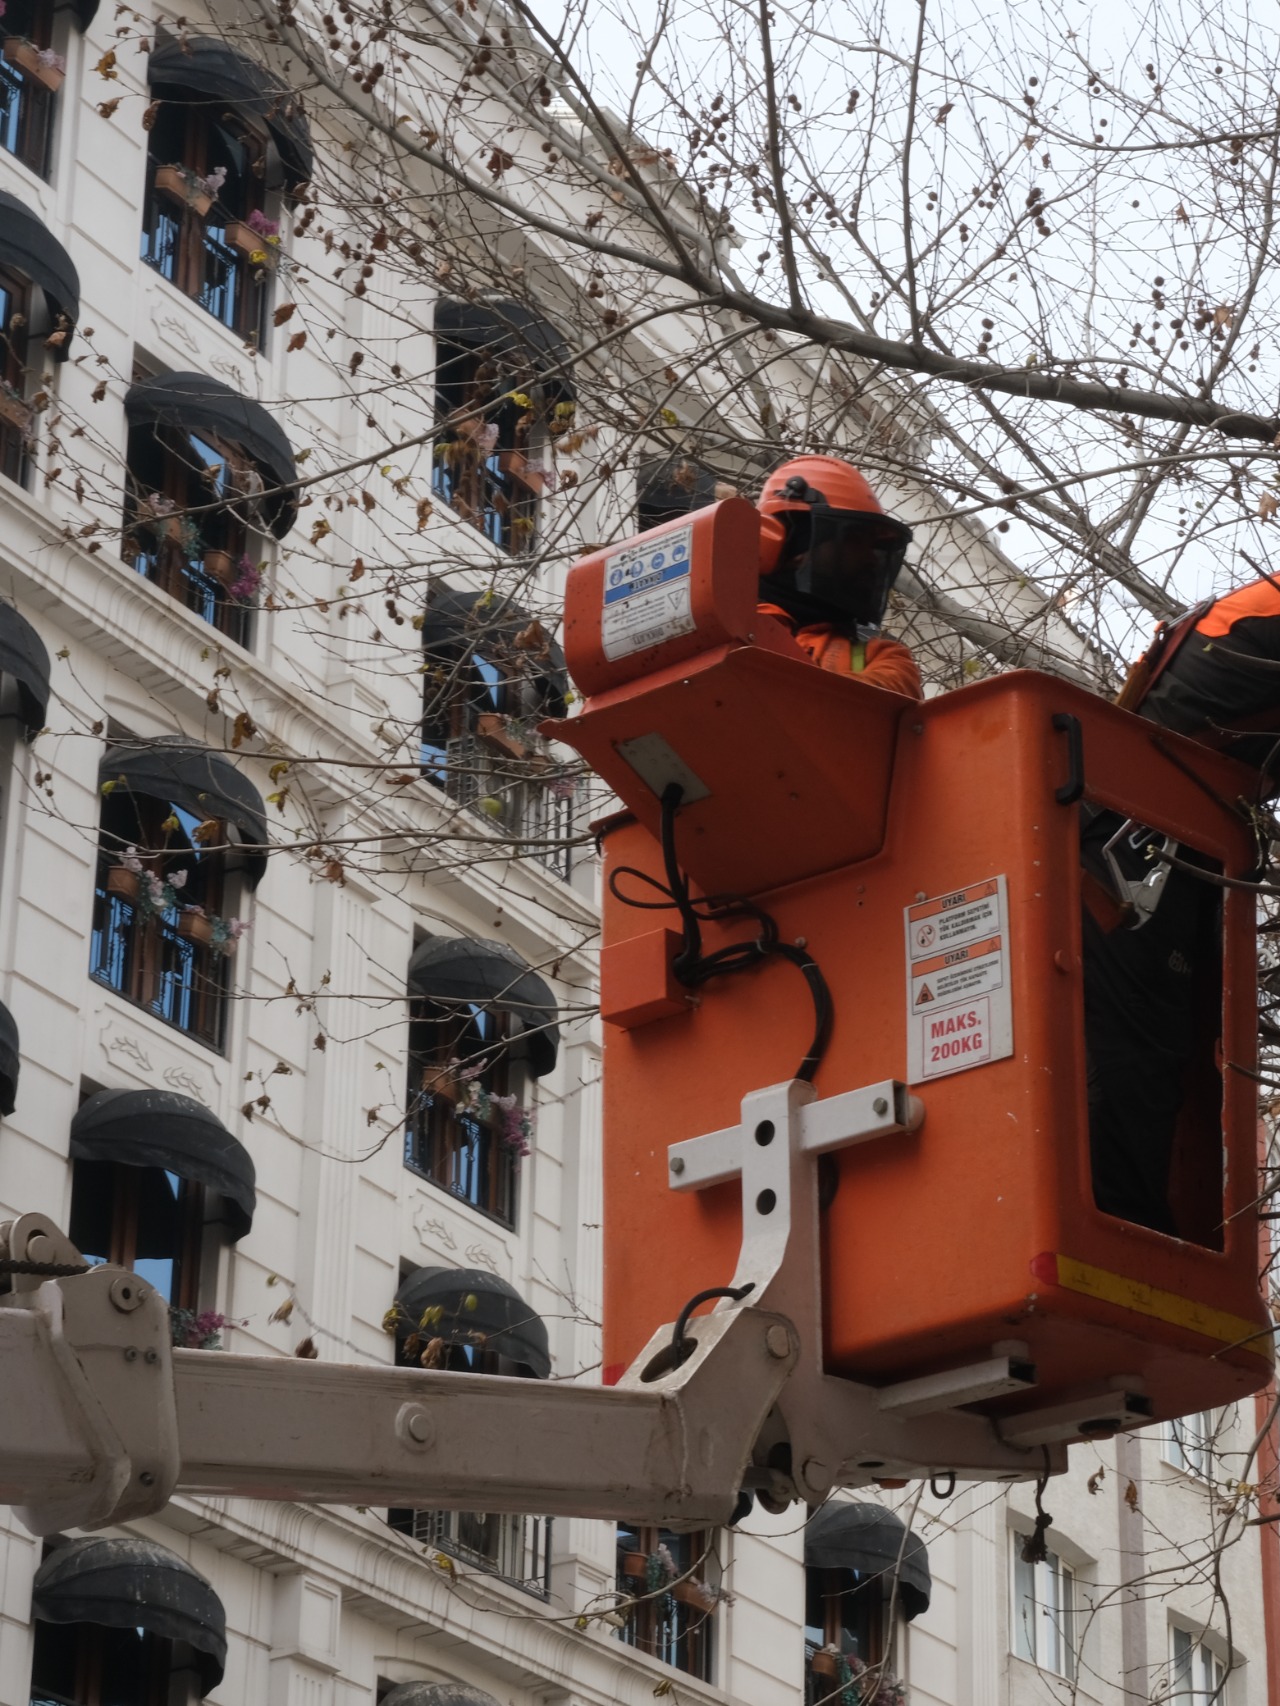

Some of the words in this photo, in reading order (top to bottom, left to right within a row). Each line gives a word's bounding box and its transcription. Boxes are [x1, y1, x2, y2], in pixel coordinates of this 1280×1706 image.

[629, 572, 662, 592] DİKKAT
[942, 894, 966, 909] UYARI
[944, 950, 968, 964] UYARI
[931, 1011, 981, 1039] MAKS.
[931, 1033, 982, 1062] 200KG
